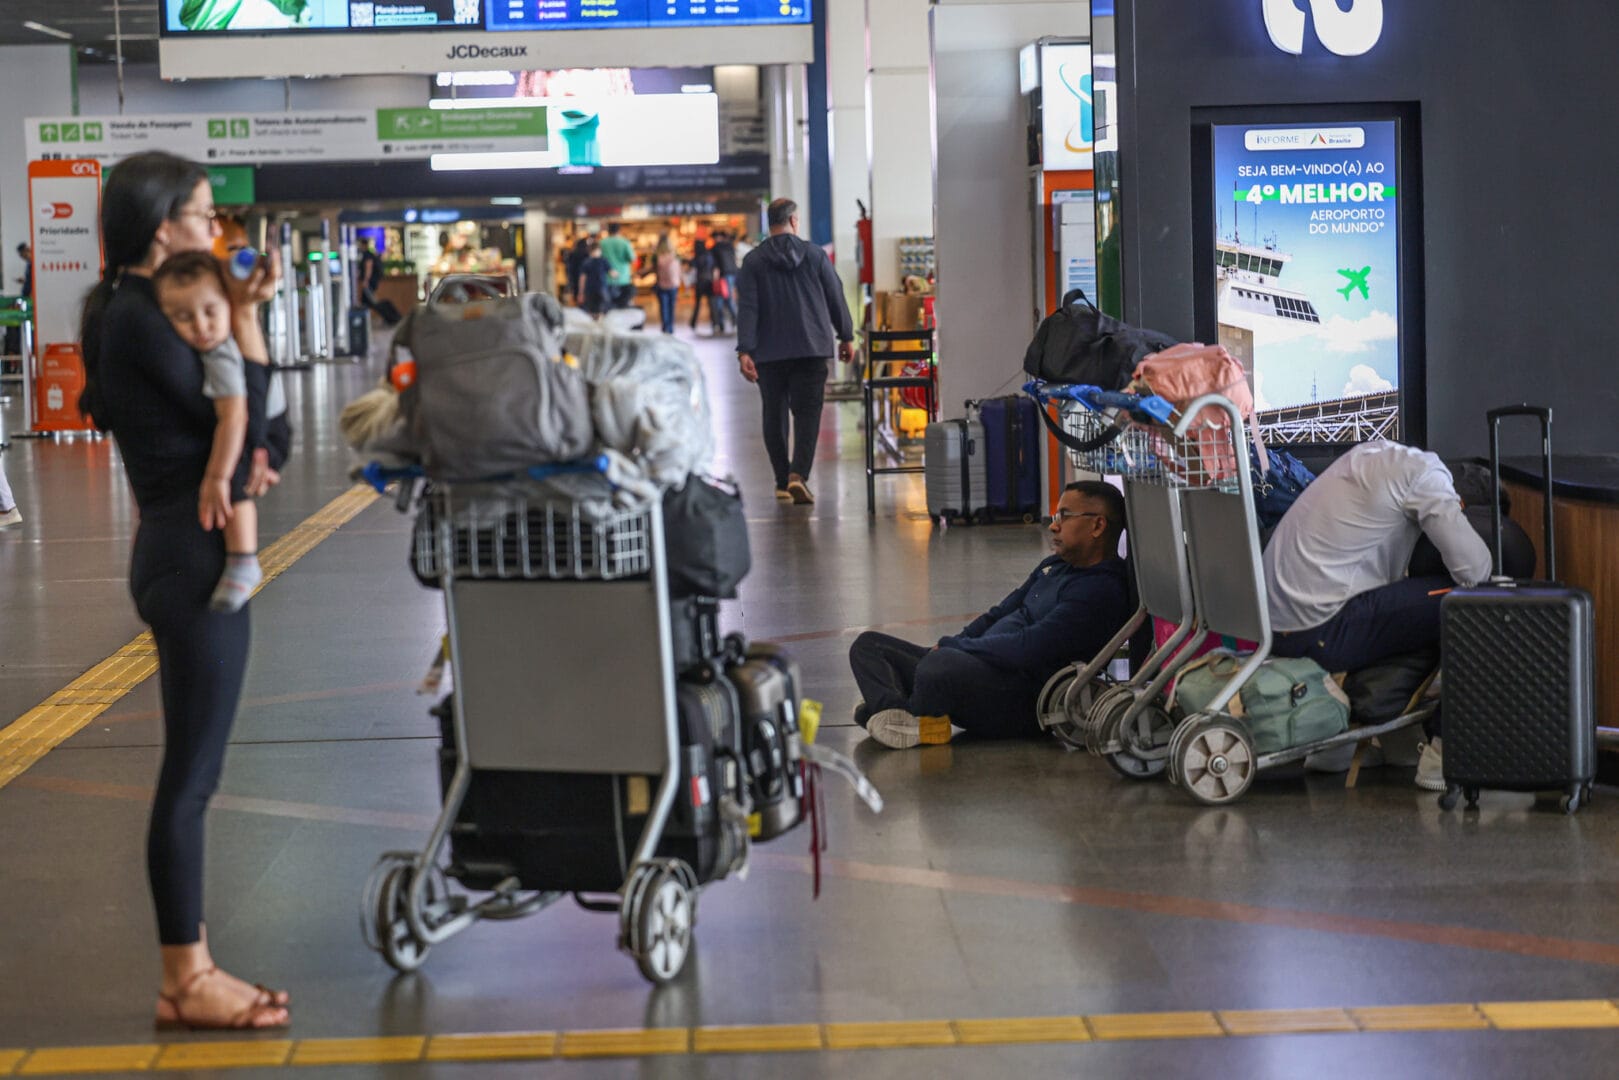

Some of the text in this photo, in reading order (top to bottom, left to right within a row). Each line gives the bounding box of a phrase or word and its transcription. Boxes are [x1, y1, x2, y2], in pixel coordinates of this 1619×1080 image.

[446, 45, 528, 59] JCDecaux
[1238, 160, 1385, 177] SEJA BEM-VINDO(A) AO
[1279, 182, 1385, 204] MELHOR
[1310, 208, 1385, 221] AEROPORTO
[39, 226, 89, 235] Prioridades
[1309, 223, 1329, 235] DO
